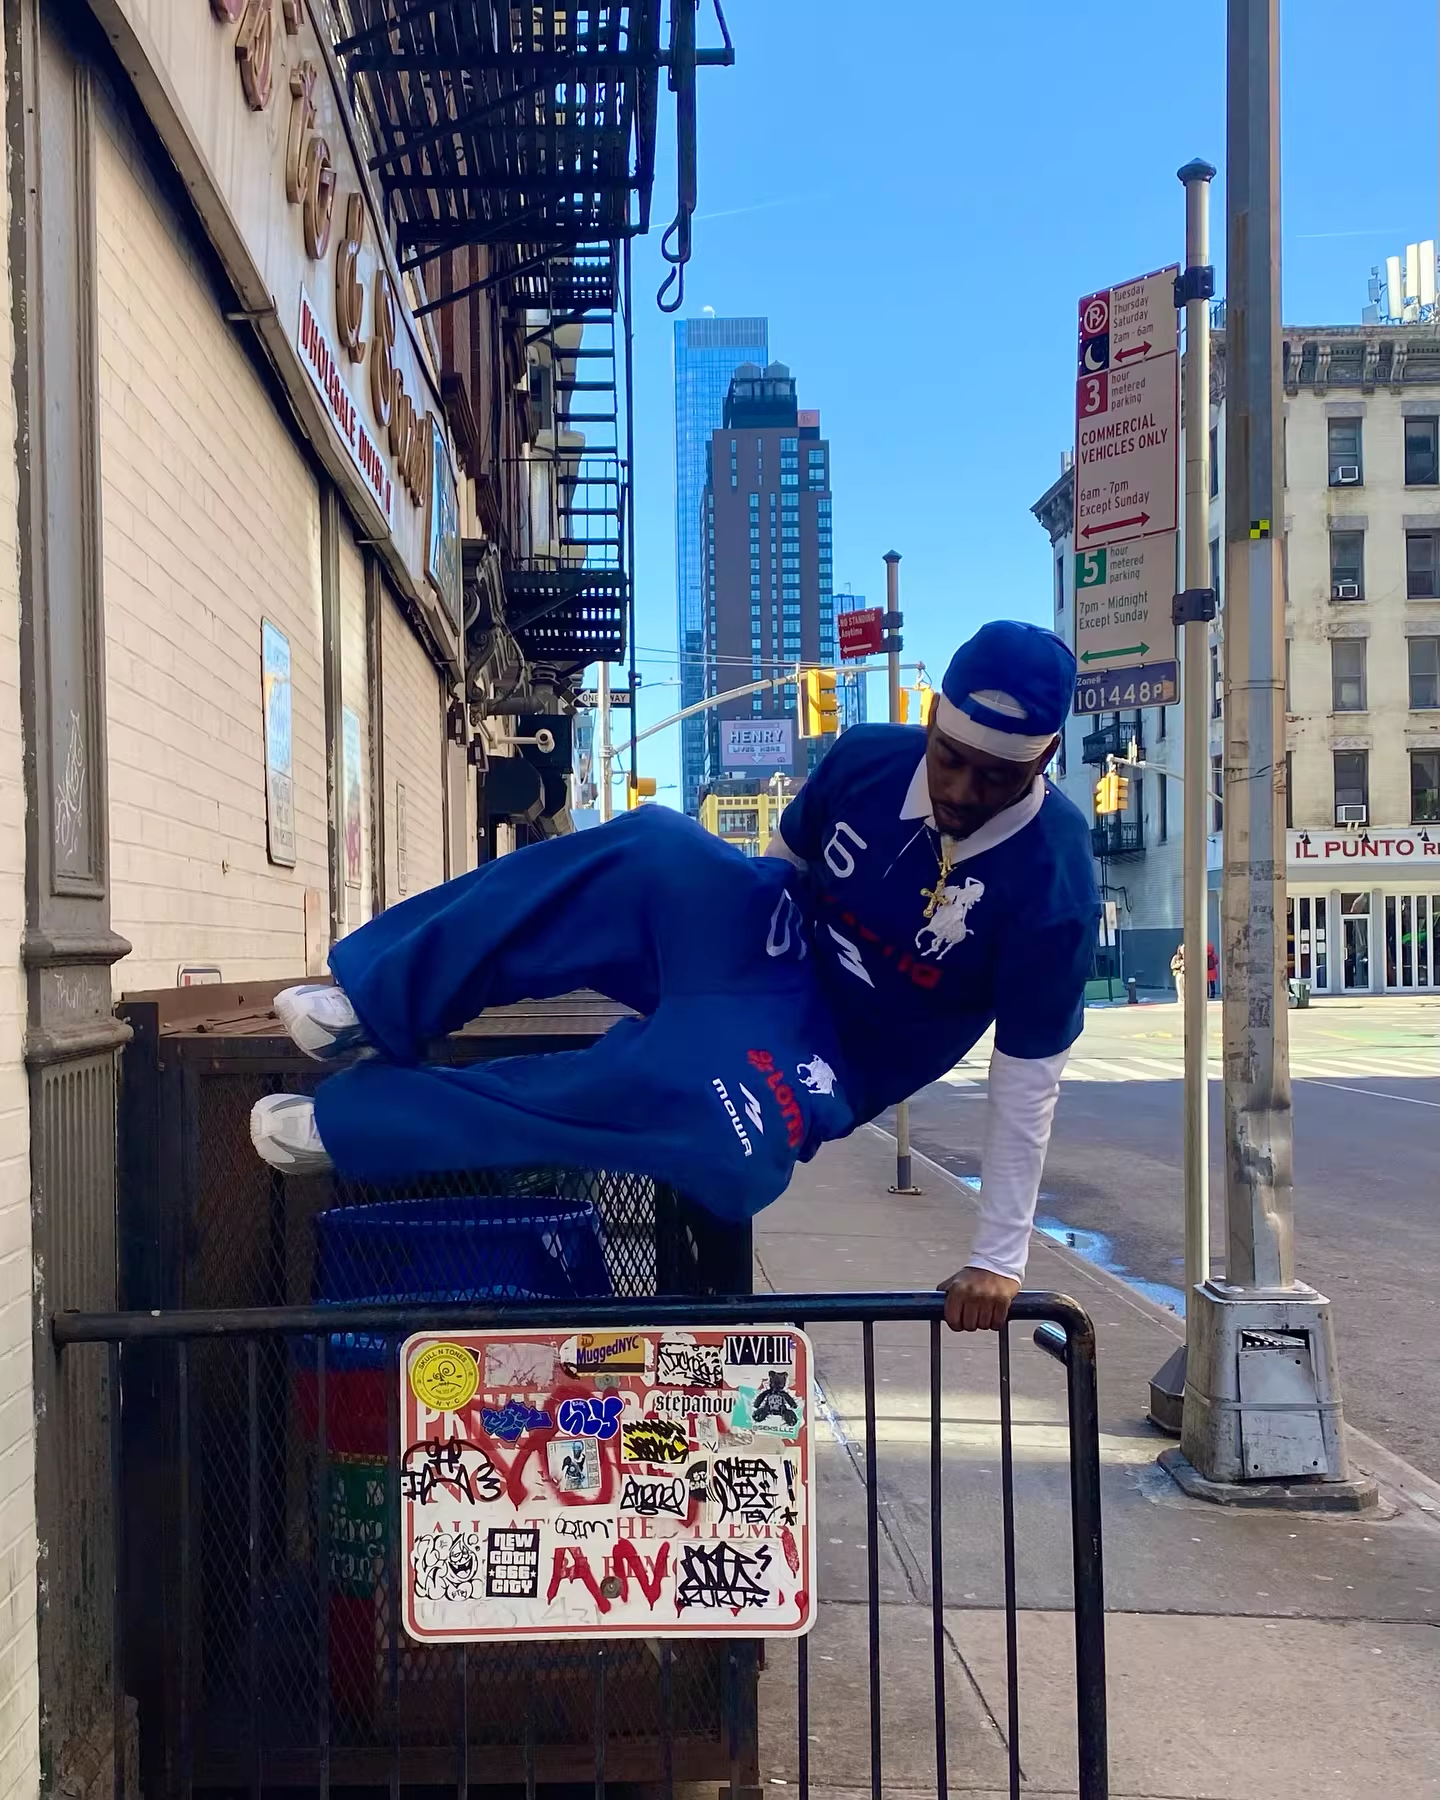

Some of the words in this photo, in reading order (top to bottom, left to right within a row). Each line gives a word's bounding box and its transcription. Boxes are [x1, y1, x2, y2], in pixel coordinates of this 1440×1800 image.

[1113, 283, 1145, 301] Tuesday
[1113, 296, 1149, 315] Thursday
[1113, 309, 1149, 329] Saturday
[1113, 332, 1130, 344] 2am
[1137, 322, 1154, 335] 6am
[1111, 371, 1130, 384] hour
[1111, 377, 1146, 397] metered
[1084, 378, 1100, 413] 3
[1111, 392, 1142, 412] parking
[302, 299, 357, 447] WHOLESALE
[359, 424, 391, 514] DIVISIN
[1081, 413, 1156, 446] COMMERCIAL
[1081, 438, 1135, 464] VEHICLES
[1138, 428, 1168, 449] ONLY
[1080, 487, 1100, 501] 6am
[1109, 479, 1129, 495] 7pm
[1080, 499, 1111, 517] Except
[1114, 491, 1150, 509] Sunday
[1110, 546, 1128, 557] hour
[1083, 551, 1099, 583] 5
[1110, 554, 1144, 570] metered
[1110, 568, 1140, 585] parking
[1079, 601, 1099, 614] 7pm
[1108, 591, 1148, 609] Midnight
[840, 618, 848, 627] NO
[848, 613, 876, 626] STANDING
[1079, 613, 1110, 630] Except
[1114, 607, 1149, 625] Sunday
[582, 693, 599, 702] ONE
[1077, 681, 1151, 711] 101448
[730, 730, 783, 743] HENRY
[1295, 841, 1319, 858] IL
[1325, 839, 1415, 858] PUNTO
[418, 1351, 438, 1370] SKULL
[444, 1348, 467, 1363] TONES
[576, 1334, 640, 1365] MuggedNYC
[494, 1532, 534, 1551] NEW
[489, 1550, 537, 1565] GOTH
[495, 1565, 530, 1580] 666
[491, 1579, 533, 1594] CITY
